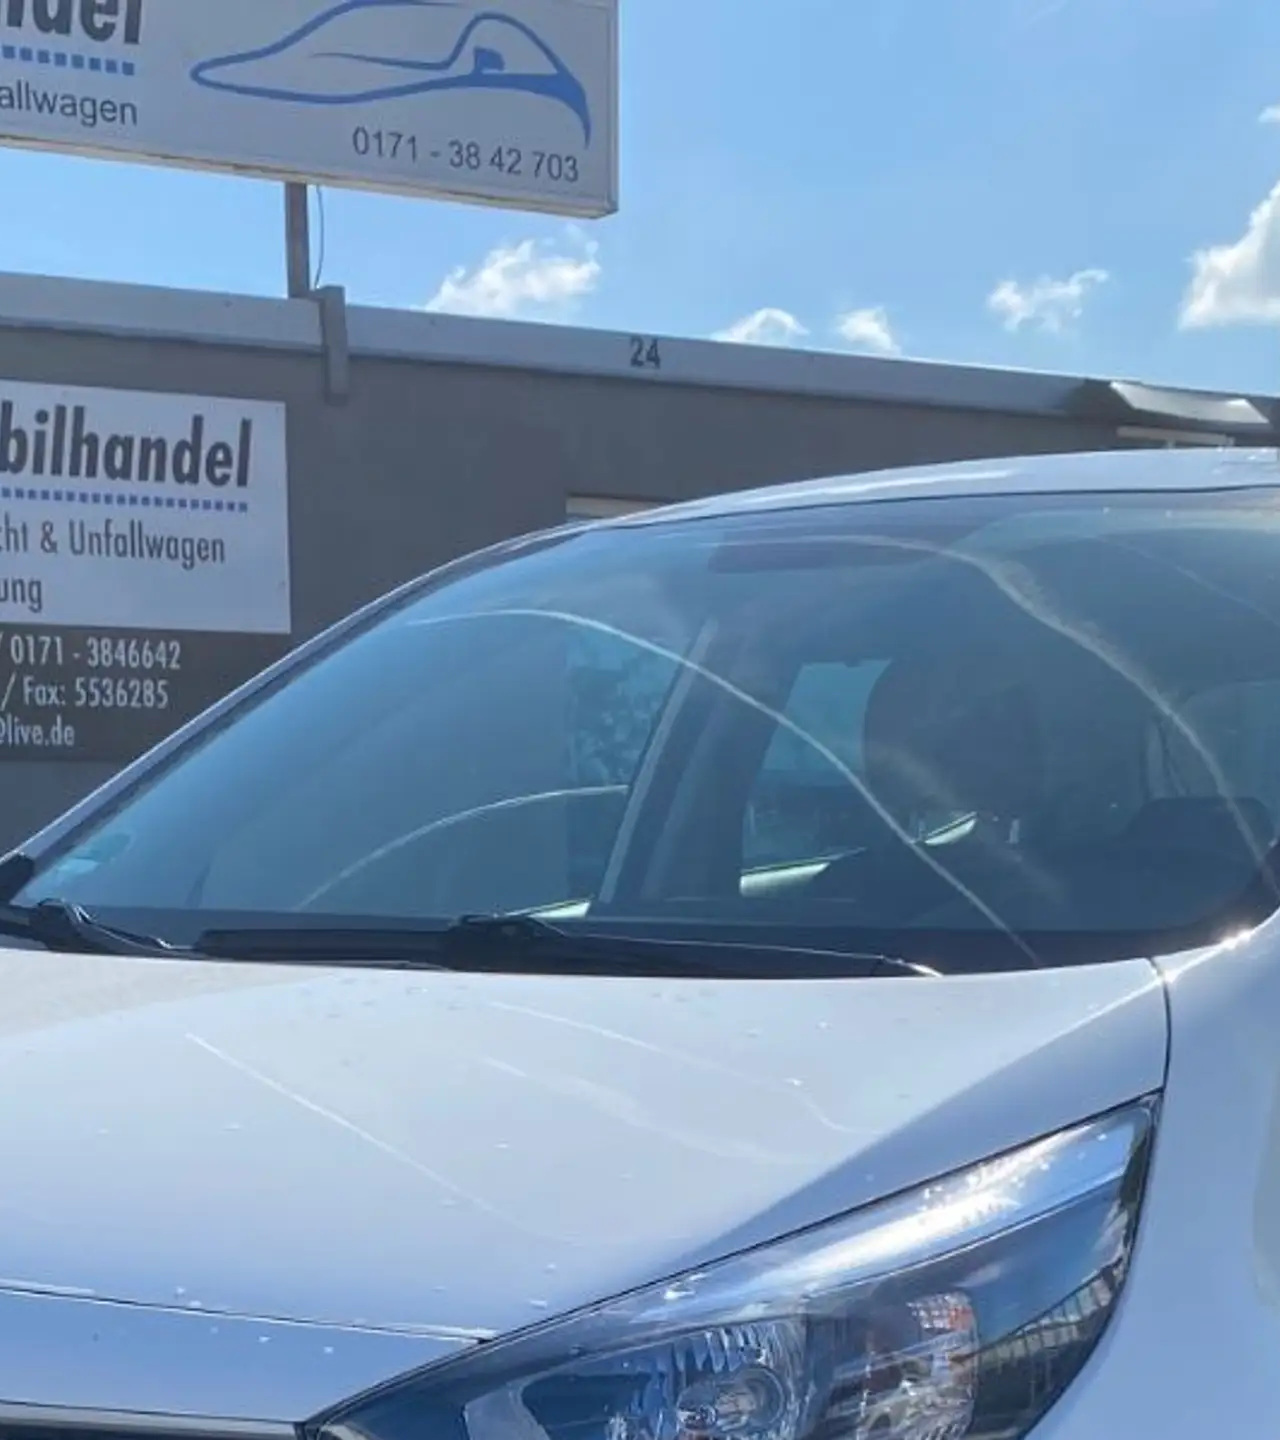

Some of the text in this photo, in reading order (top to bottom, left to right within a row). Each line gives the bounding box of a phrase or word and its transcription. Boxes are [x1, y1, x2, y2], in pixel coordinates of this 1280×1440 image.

[352, 126, 418, 163] 0171
[449, 139, 481, 170] 38
[489, 146, 522, 175] 42
[532, 151, 579, 182] 703
[630, 335, 661, 369] 24
[40, 520, 58, 554] &
[69, 518, 226, 570] Unfallwagen
[10, 634, 63, 666] 0171
[86, 637, 181, 669] 3846642
[23, 675, 66, 706] Fax:
[75, 677, 169, 709] 5536285
